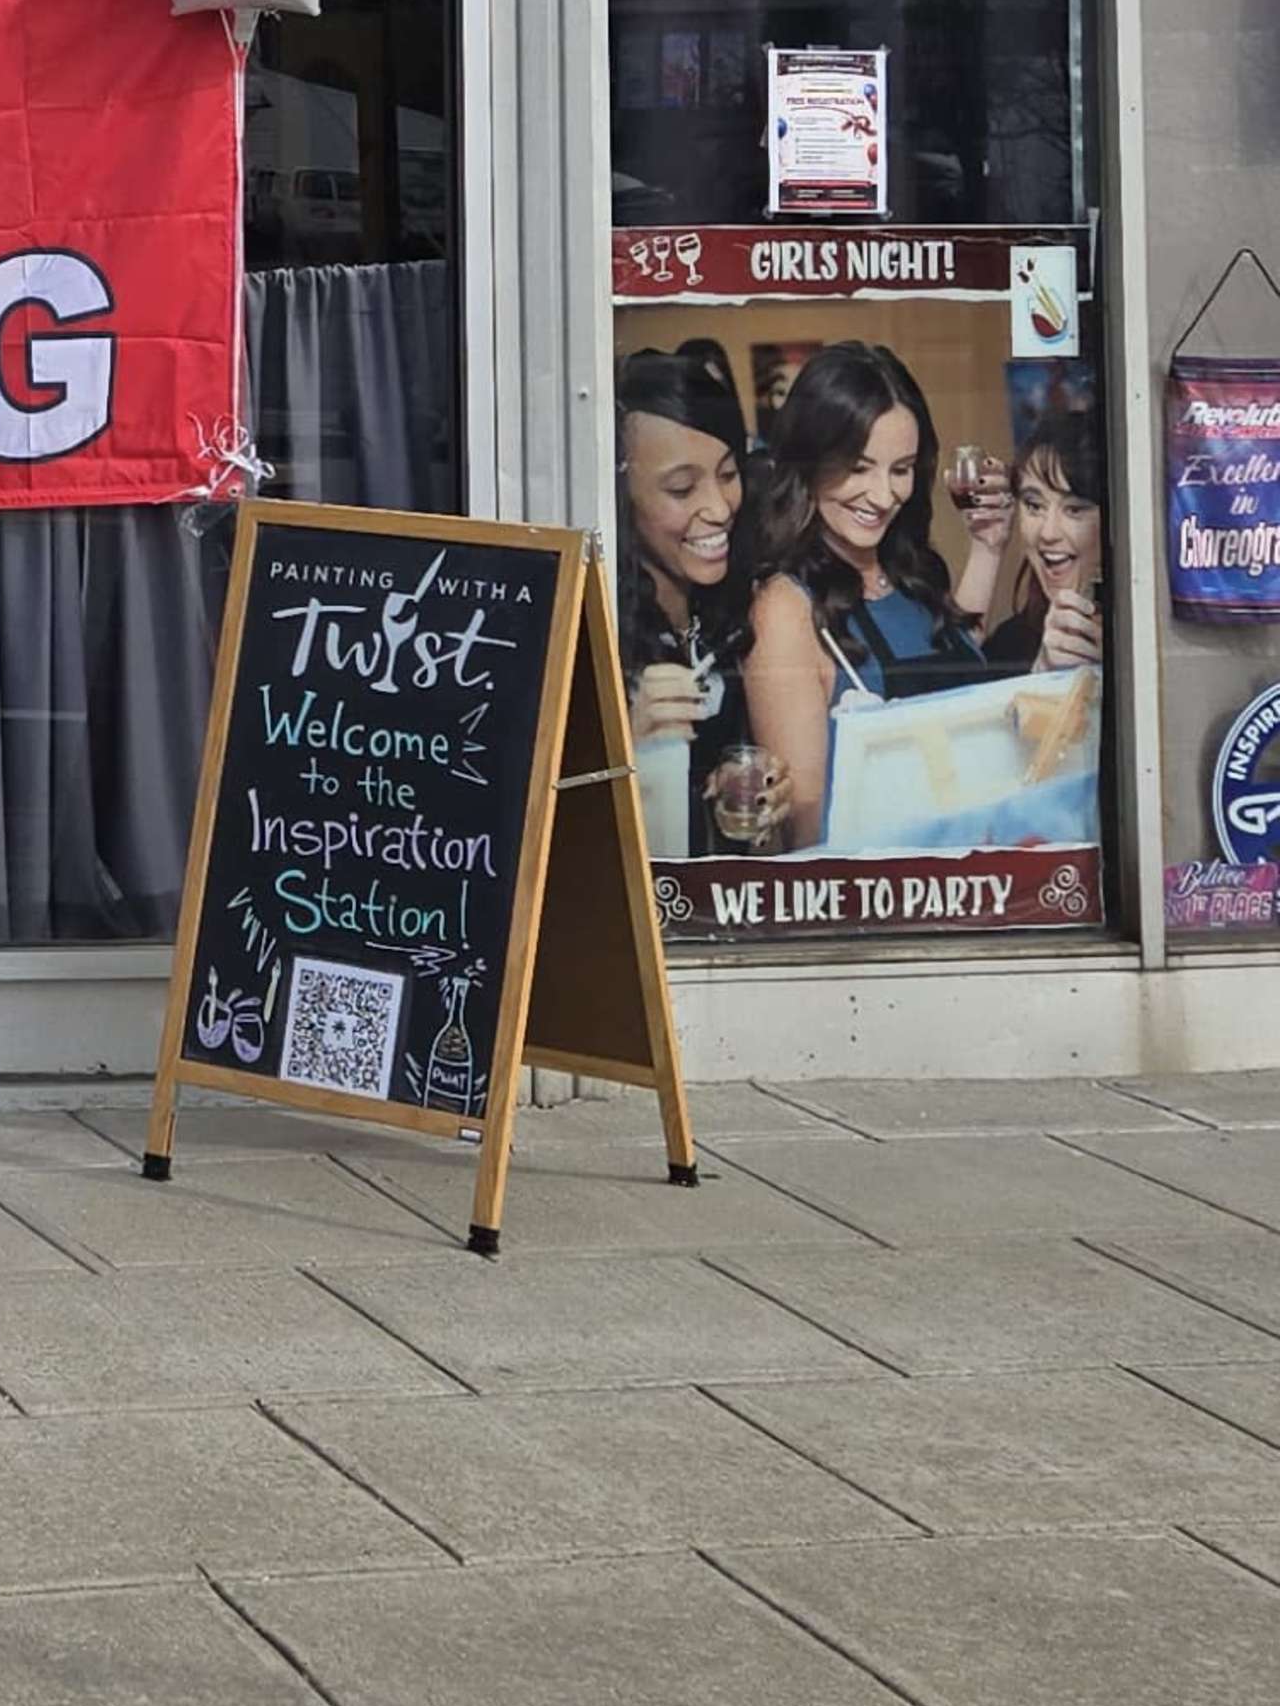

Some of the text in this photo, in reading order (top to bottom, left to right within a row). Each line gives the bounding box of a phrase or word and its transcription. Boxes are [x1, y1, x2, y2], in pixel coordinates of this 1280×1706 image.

[751, 241, 956, 281] GIRLS NIGHT!
[270, 562, 533, 604] PAINTING WITH A
[259, 684, 449, 765] Welcome
[300, 757, 416, 810] to the
[248, 787, 497, 878] Inspiration
[275, 869, 469, 950] Station!
[711, 874, 1014, 926] WE LIKE TO PARTY
